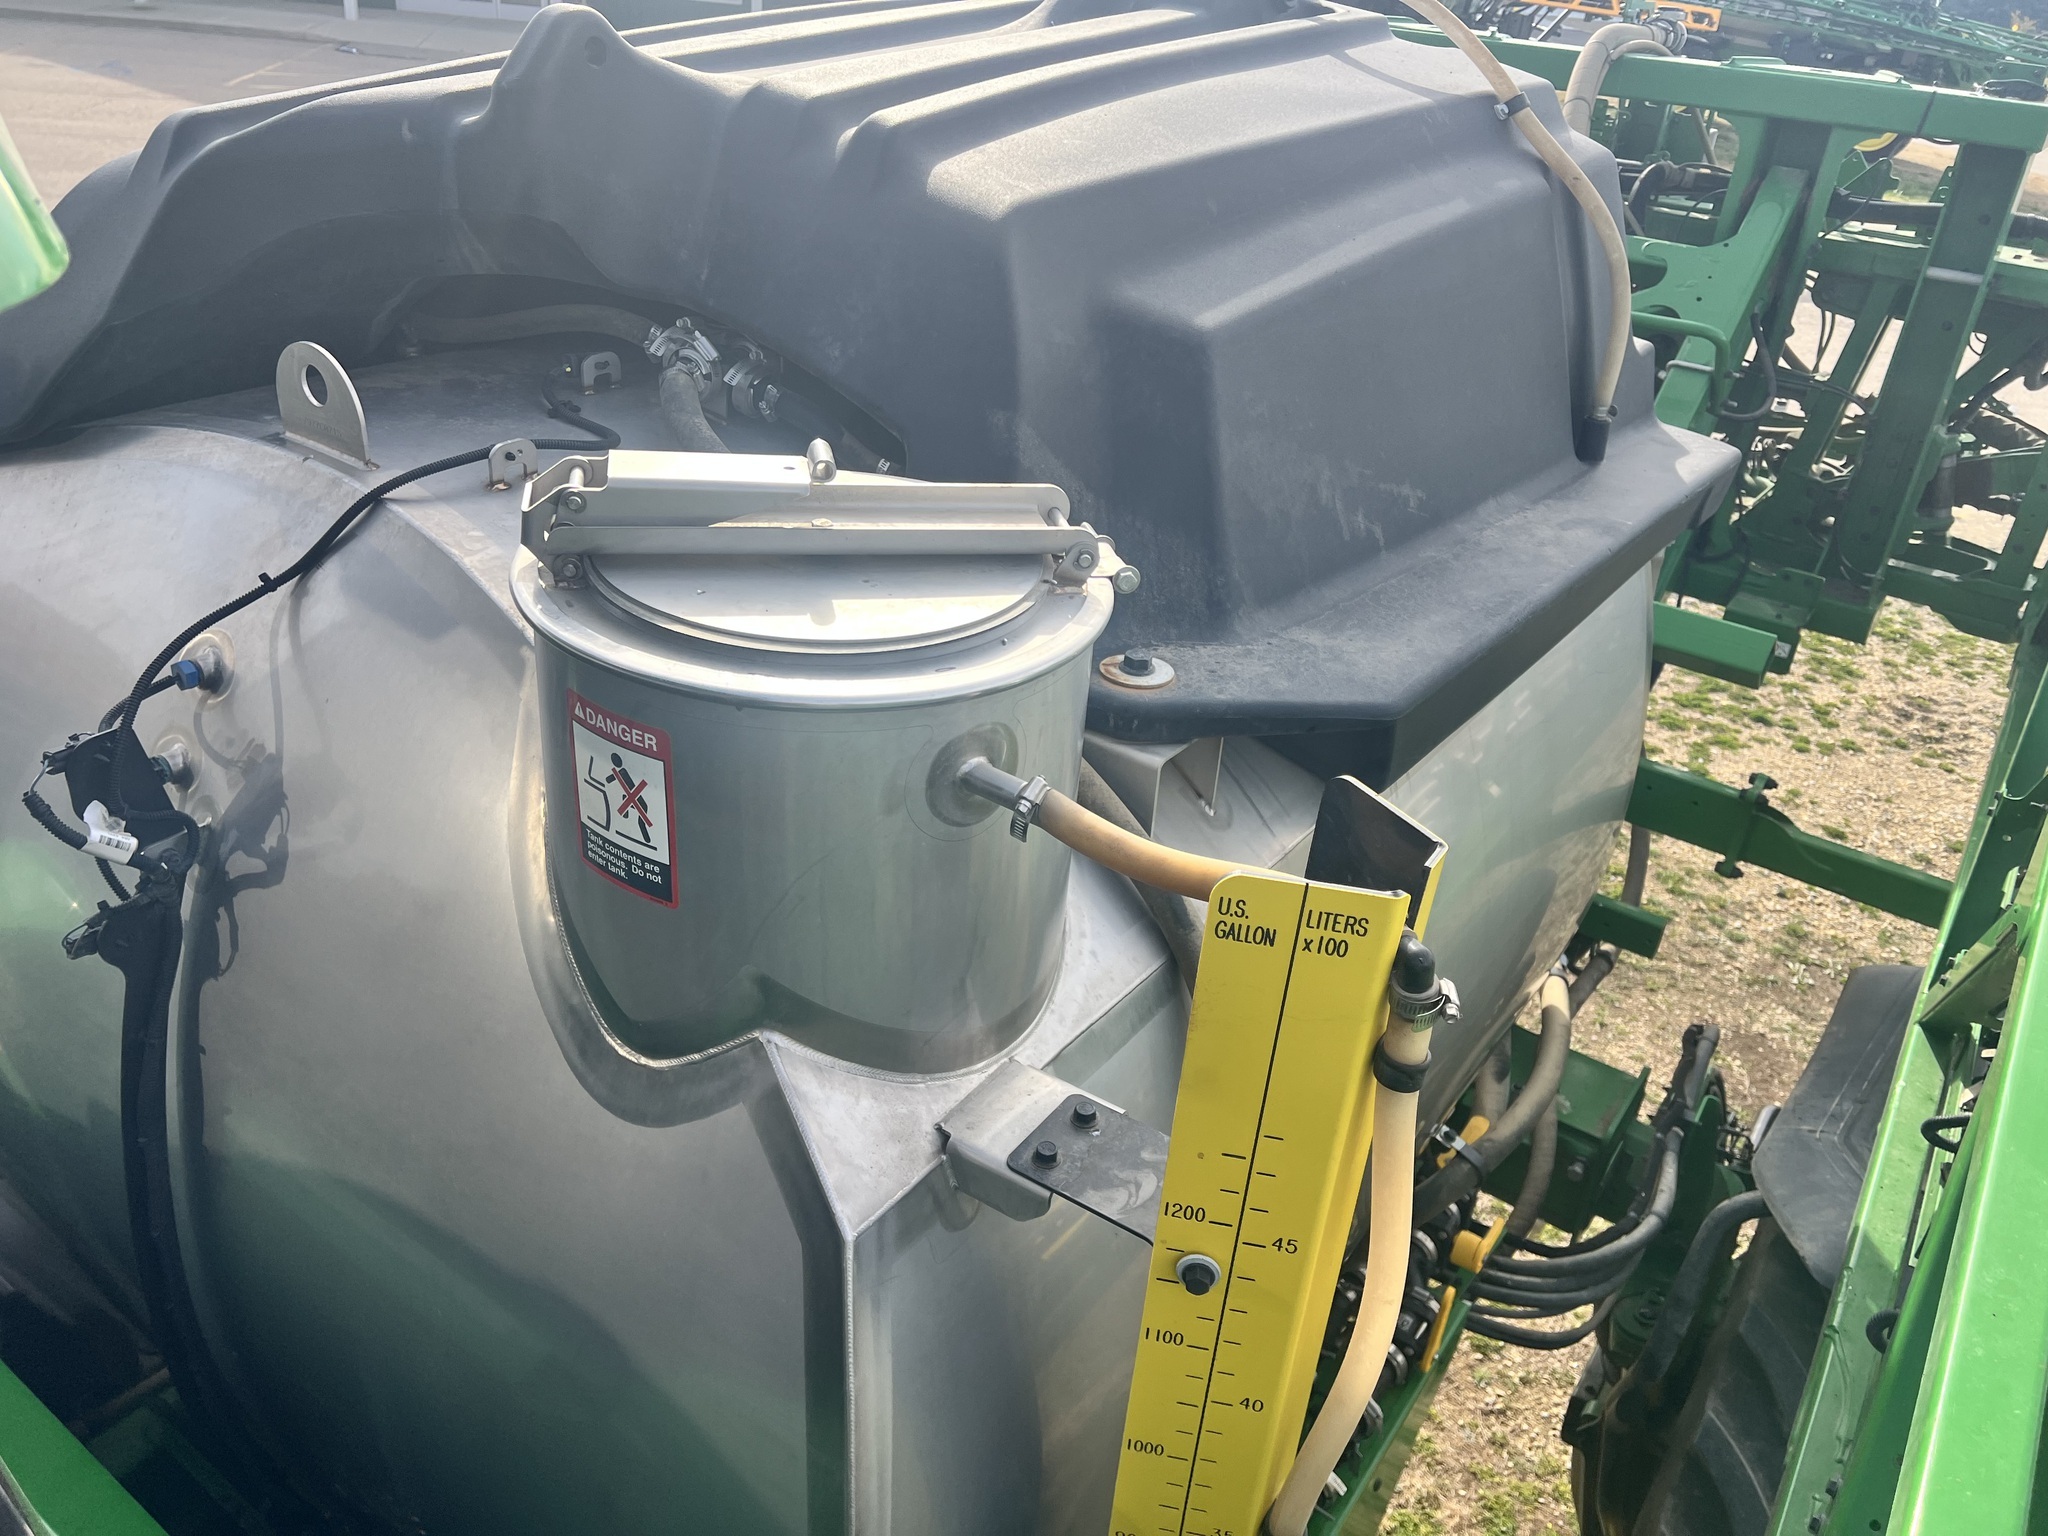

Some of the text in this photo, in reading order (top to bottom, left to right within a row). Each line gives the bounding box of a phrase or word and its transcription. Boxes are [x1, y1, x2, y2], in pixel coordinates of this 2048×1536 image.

[586, 707, 657, 752] DANGER
[586, 829, 660, 874] Tank contents are
[587, 841, 662, 884] poisonous. Do not
[588, 851, 629, 880] enter tank.
[1218, 896, 1249, 919] U.S.
[1214, 920, 1277, 948] GALLON
[1306, 909, 1369, 937] LITERS
[1302, 935, 1349, 958] x100
[1164, 1202, 1206, 1222] 1200
[1272, 1237, 1298, 1254] 45
[1145, 1327, 1184, 1346] 1100
[1239, 1397, 1264, 1413] 40
[1127, 1438, 1165, 1456] 1000
